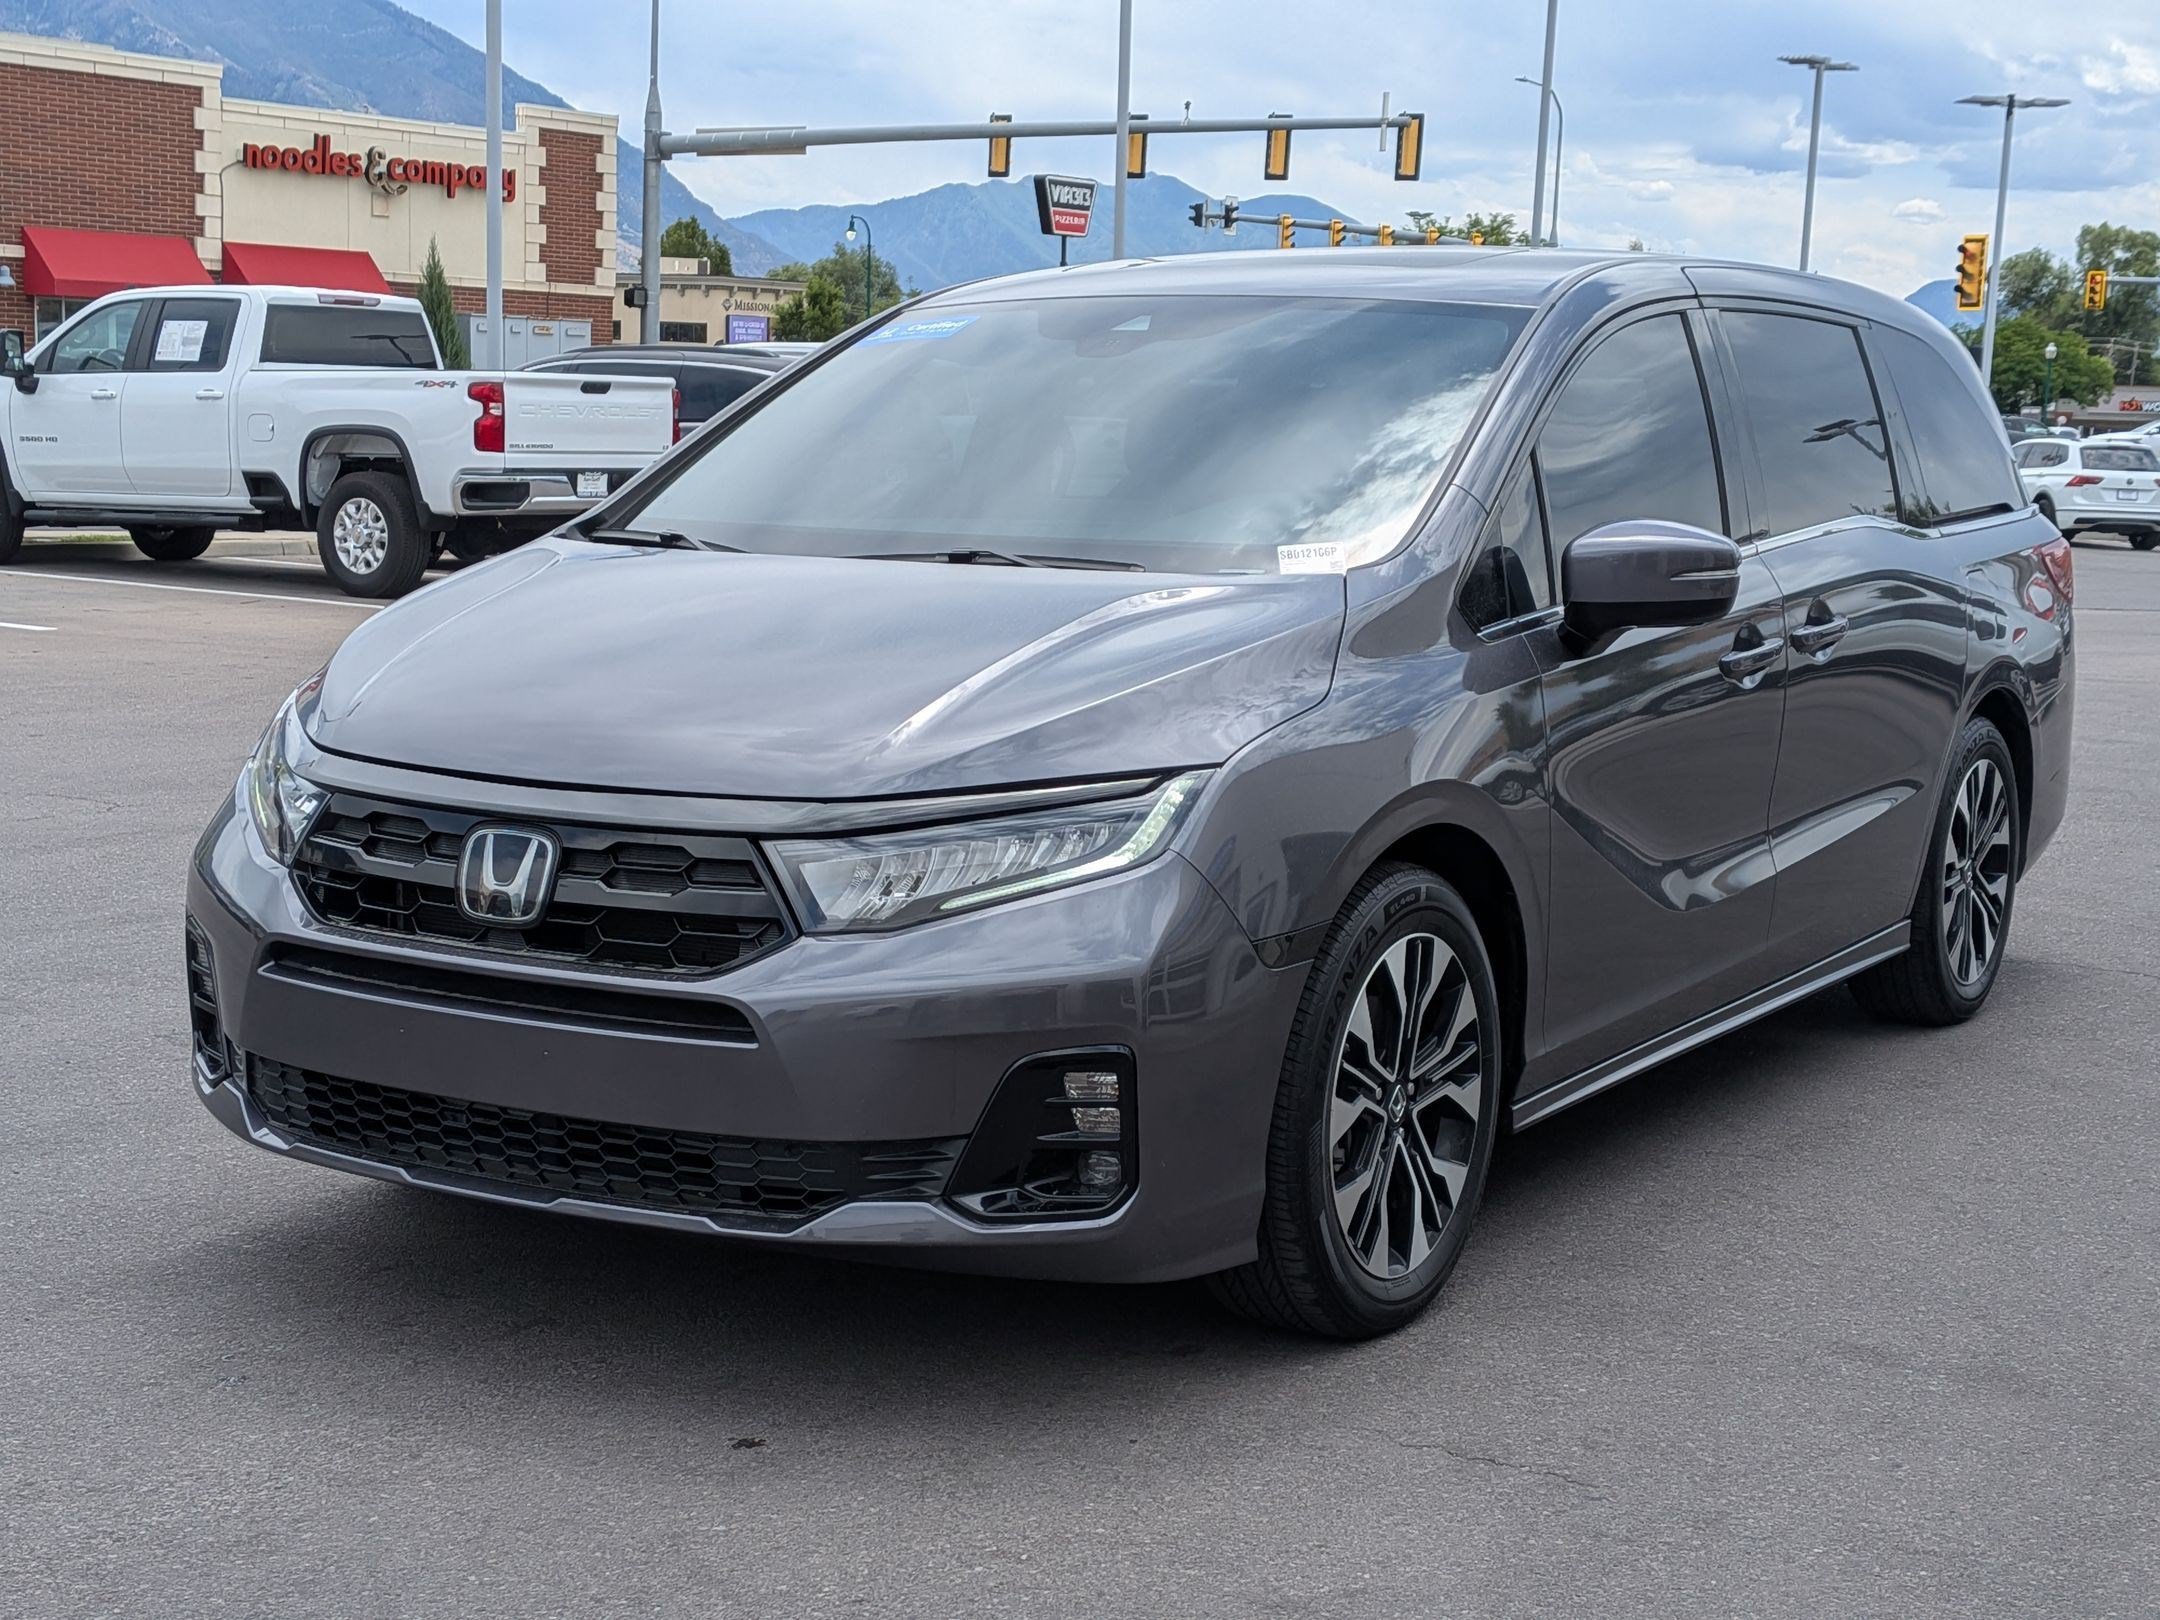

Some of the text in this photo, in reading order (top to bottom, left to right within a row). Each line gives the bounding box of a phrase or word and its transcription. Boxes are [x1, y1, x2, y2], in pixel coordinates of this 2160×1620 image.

[243, 133, 362, 178] noodles
[386, 157, 517, 203] compay
[519, 403, 664, 420] CHEVROLET
